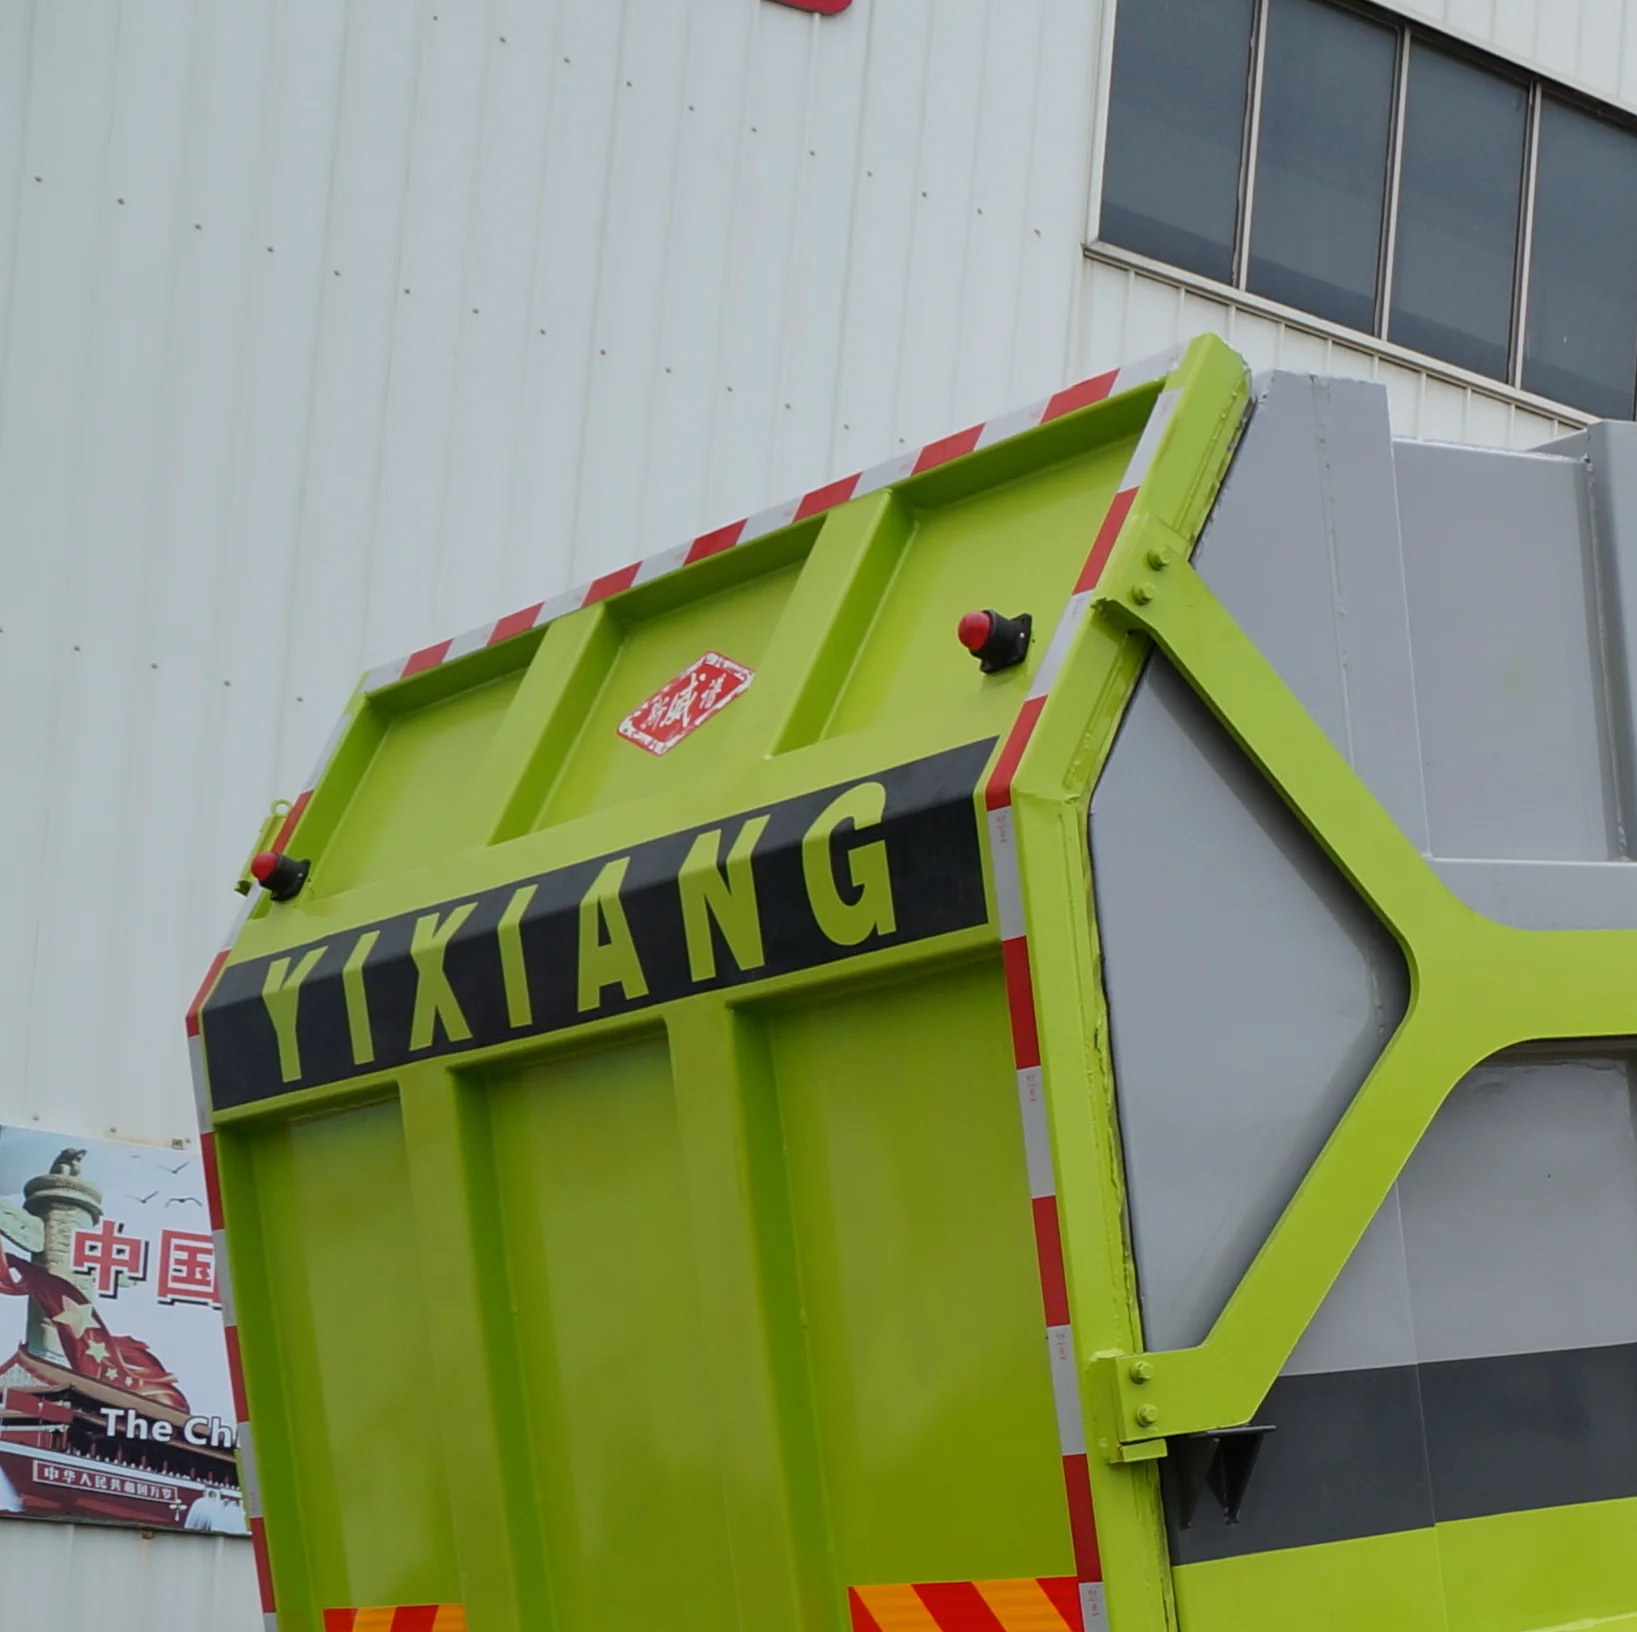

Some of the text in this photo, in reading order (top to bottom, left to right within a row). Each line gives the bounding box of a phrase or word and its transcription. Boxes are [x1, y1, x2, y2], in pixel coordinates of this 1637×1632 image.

[261, 780, 897, 1084] YIXIANG
[72, 1220, 221, 1310] 中国
[101, 1406, 173, 1444] The
